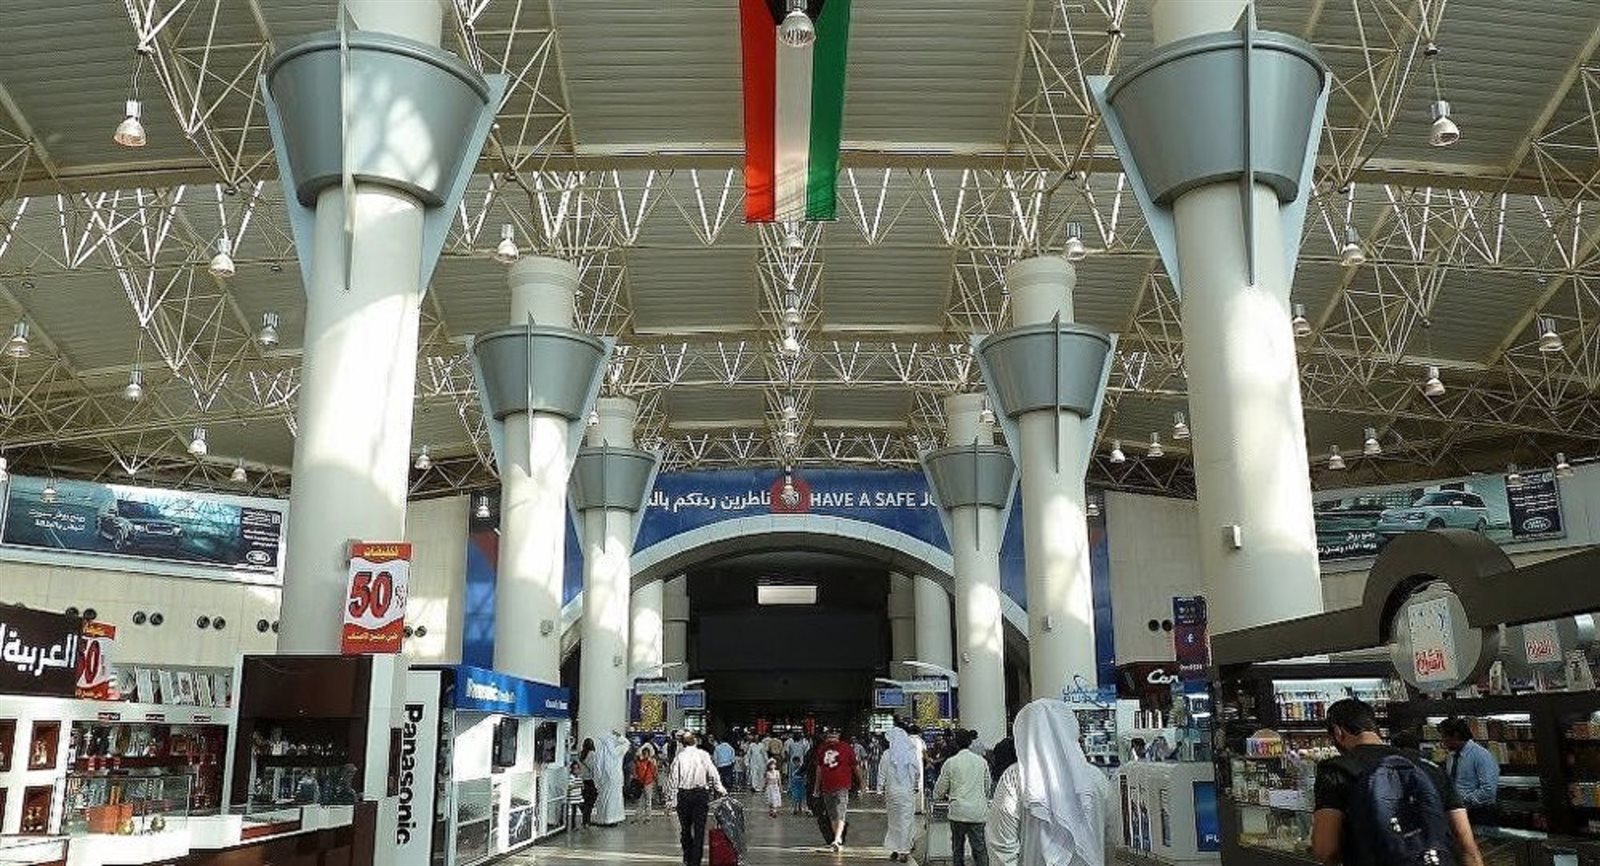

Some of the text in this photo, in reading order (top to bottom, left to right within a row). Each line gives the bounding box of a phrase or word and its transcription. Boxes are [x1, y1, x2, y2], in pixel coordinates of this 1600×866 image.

[810, 492, 853, 507] HAVE
[858, 492, 871, 507] A
[875, 492, 916, 507] SAFE
[3, 630, 78, 677] العربية
[397, 703, 425, 846] Panasonic
